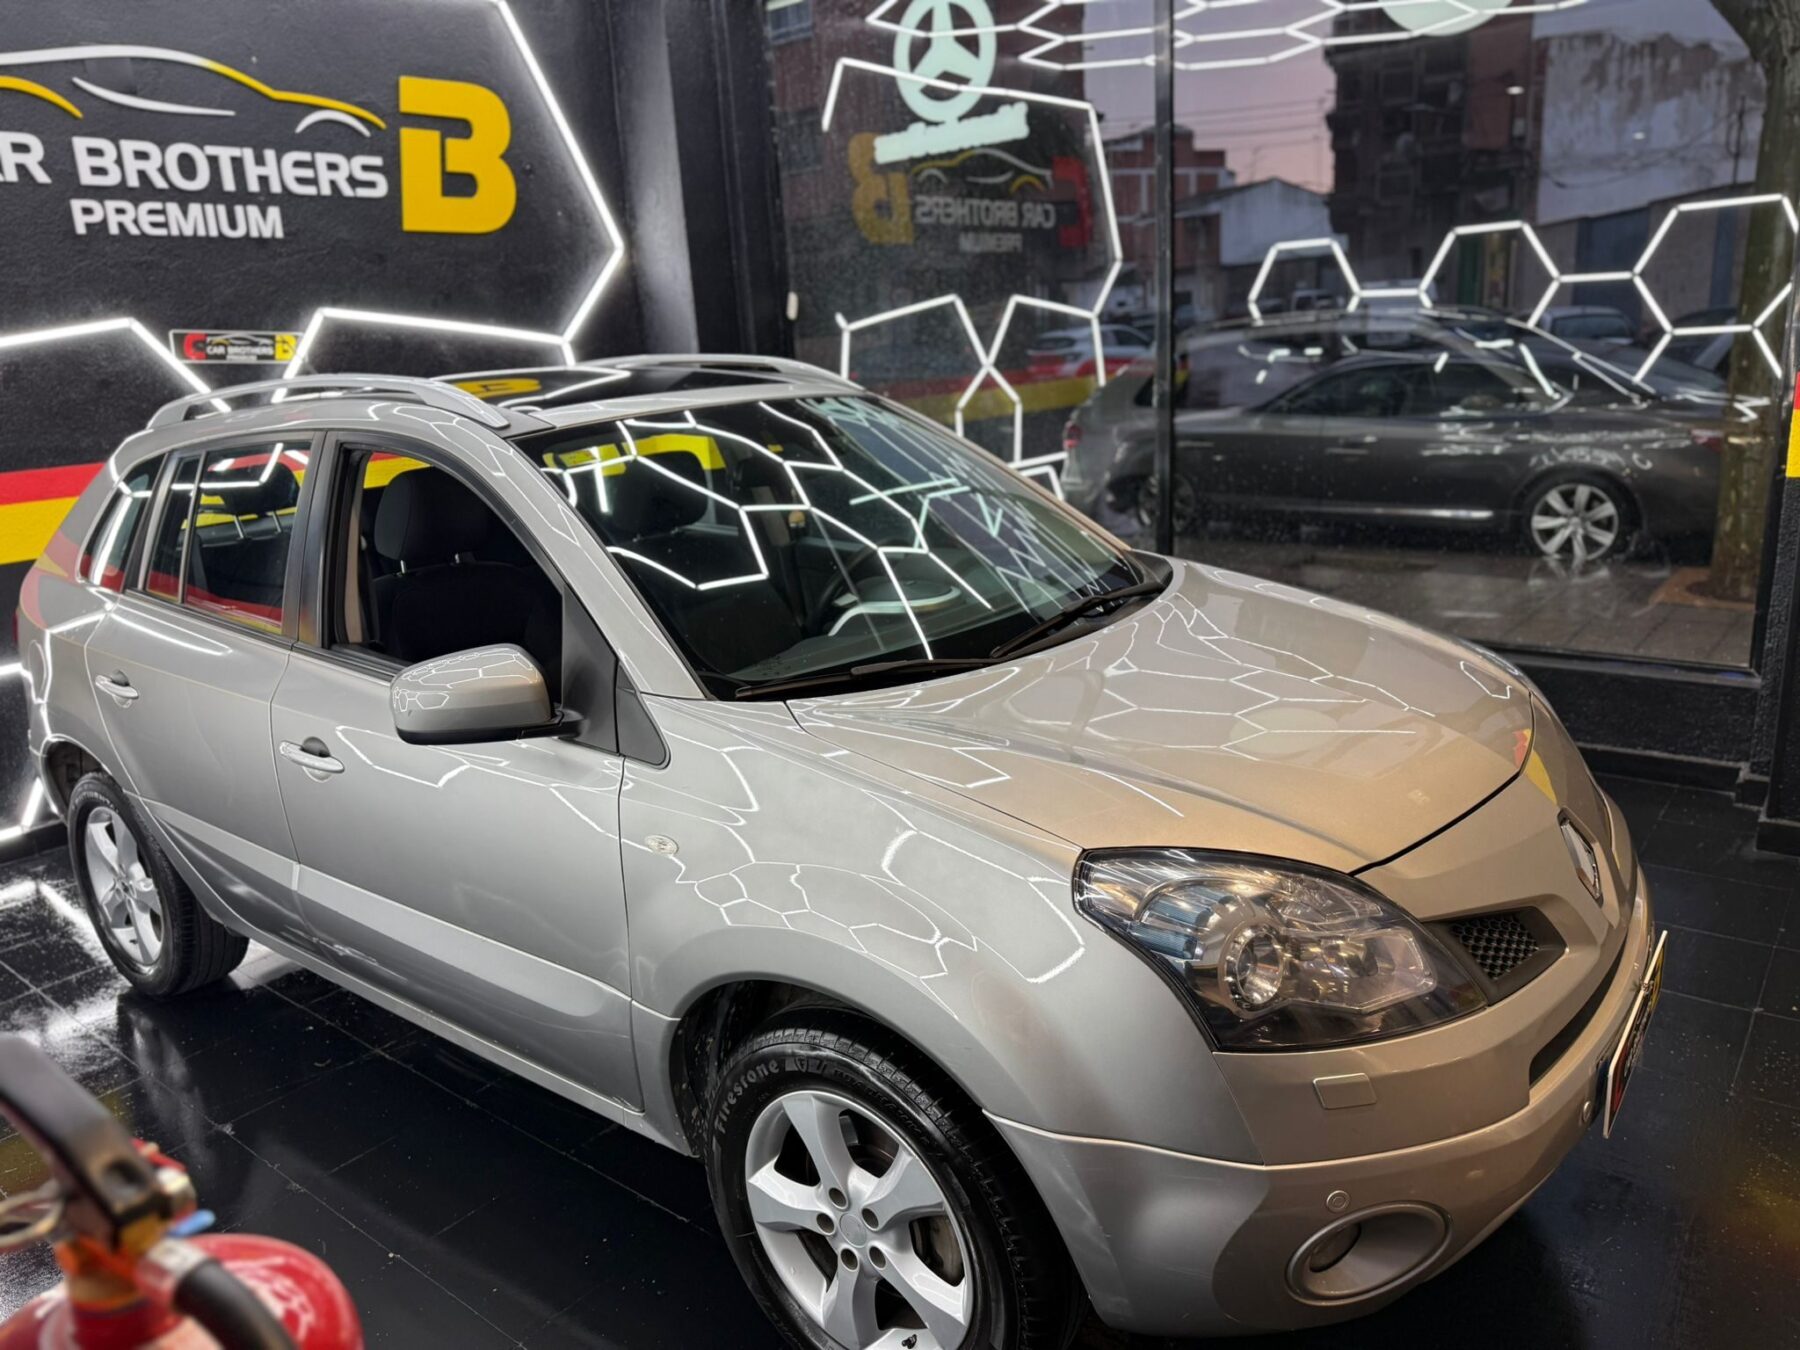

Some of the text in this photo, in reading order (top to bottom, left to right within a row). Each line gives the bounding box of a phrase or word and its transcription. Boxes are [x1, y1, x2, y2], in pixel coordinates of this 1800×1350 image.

[71, 135, 389, 199] BROTHERS
[69, 197, 285, 239] PREMIUM
[714, 1057, 780, 1135] Firestone
